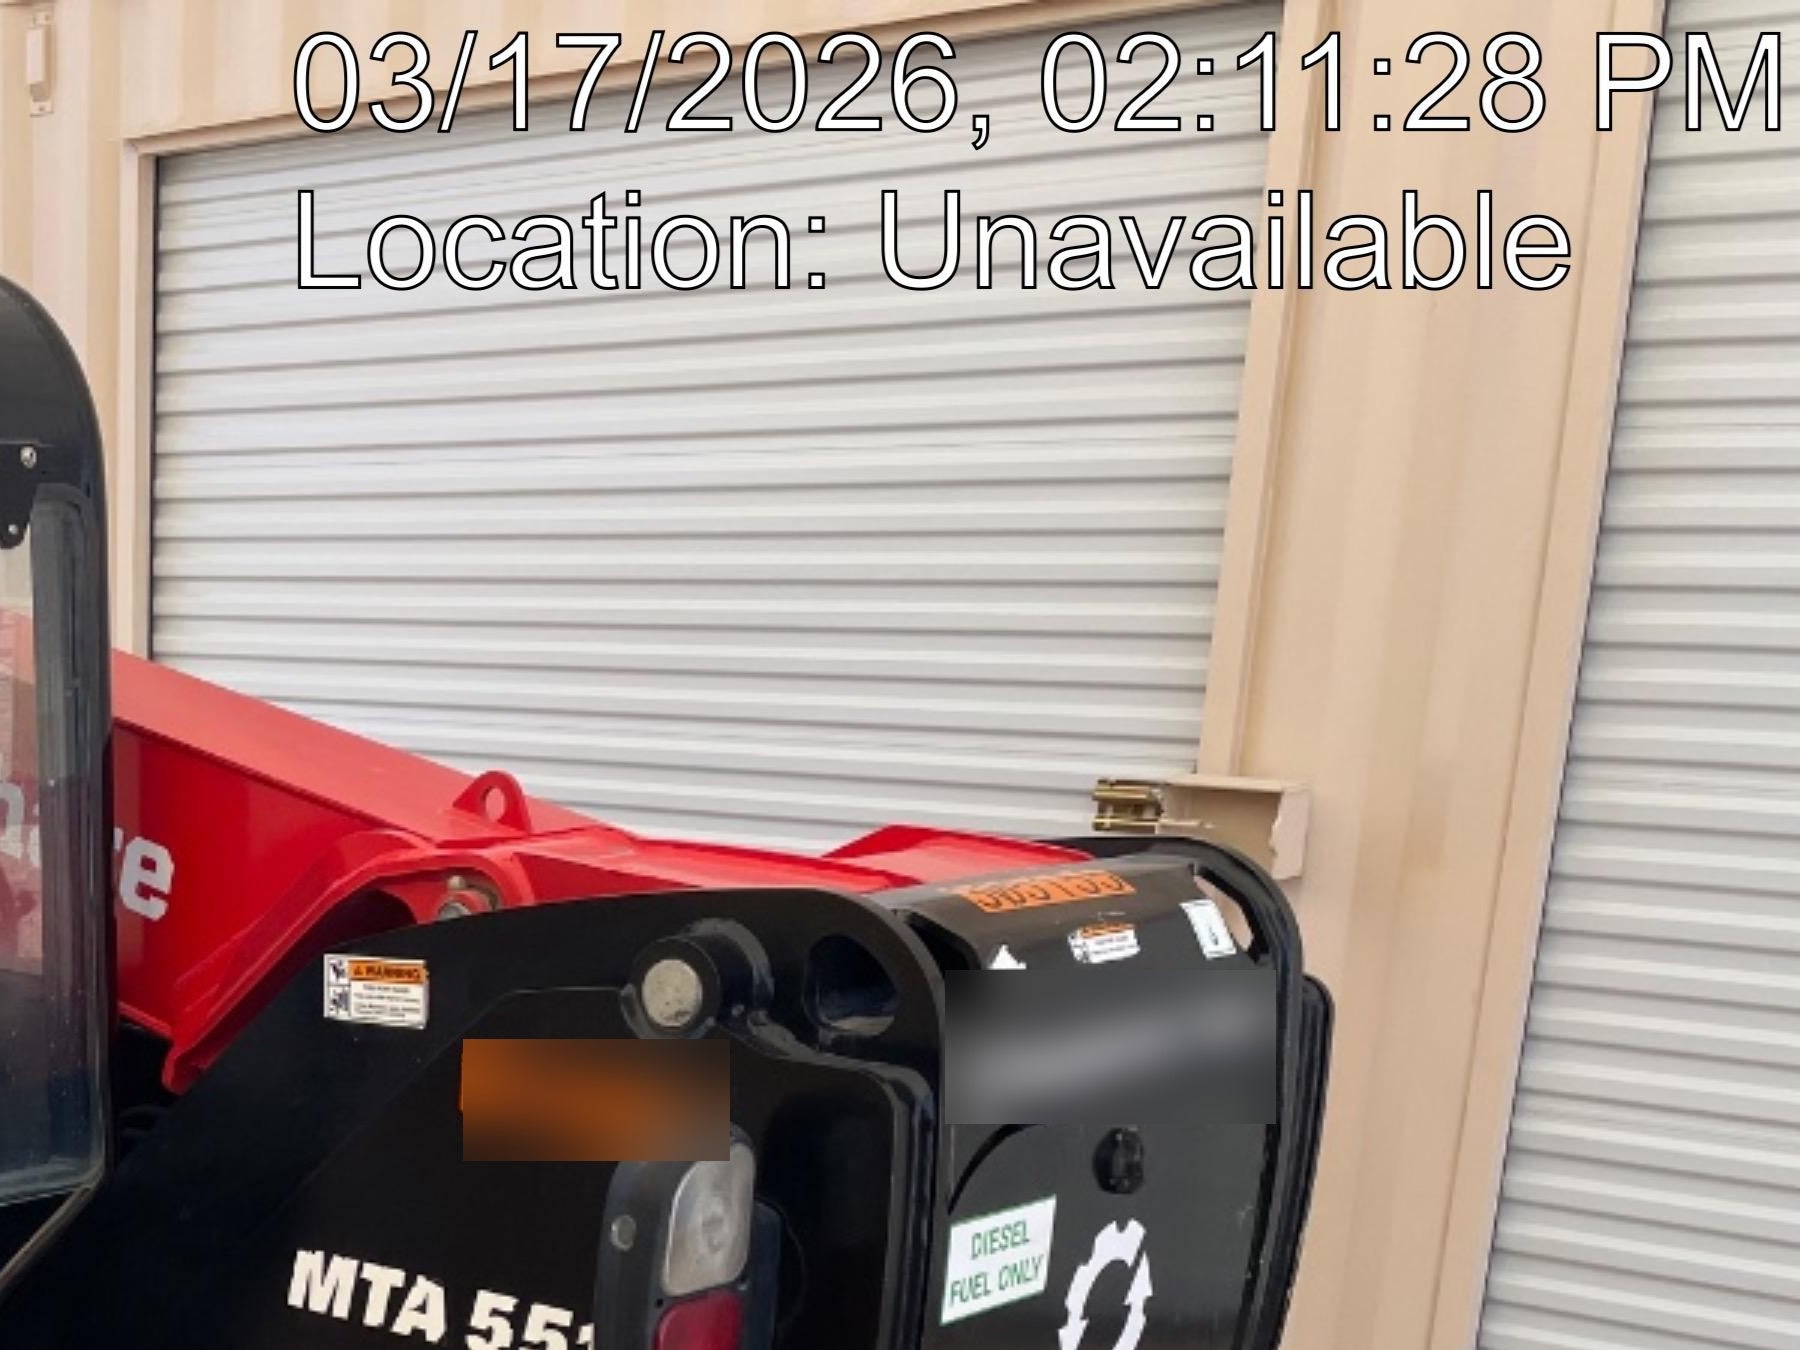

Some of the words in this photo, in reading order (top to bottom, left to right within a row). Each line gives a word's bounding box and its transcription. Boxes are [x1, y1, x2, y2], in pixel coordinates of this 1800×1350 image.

[971, 1219, 1031, 1260] DIESEL
[286, 1249, 448, 1344] MTA
[949, 1271, 992, 1307] FUEL
[998, 1253, 1045, 1291] ONLY
